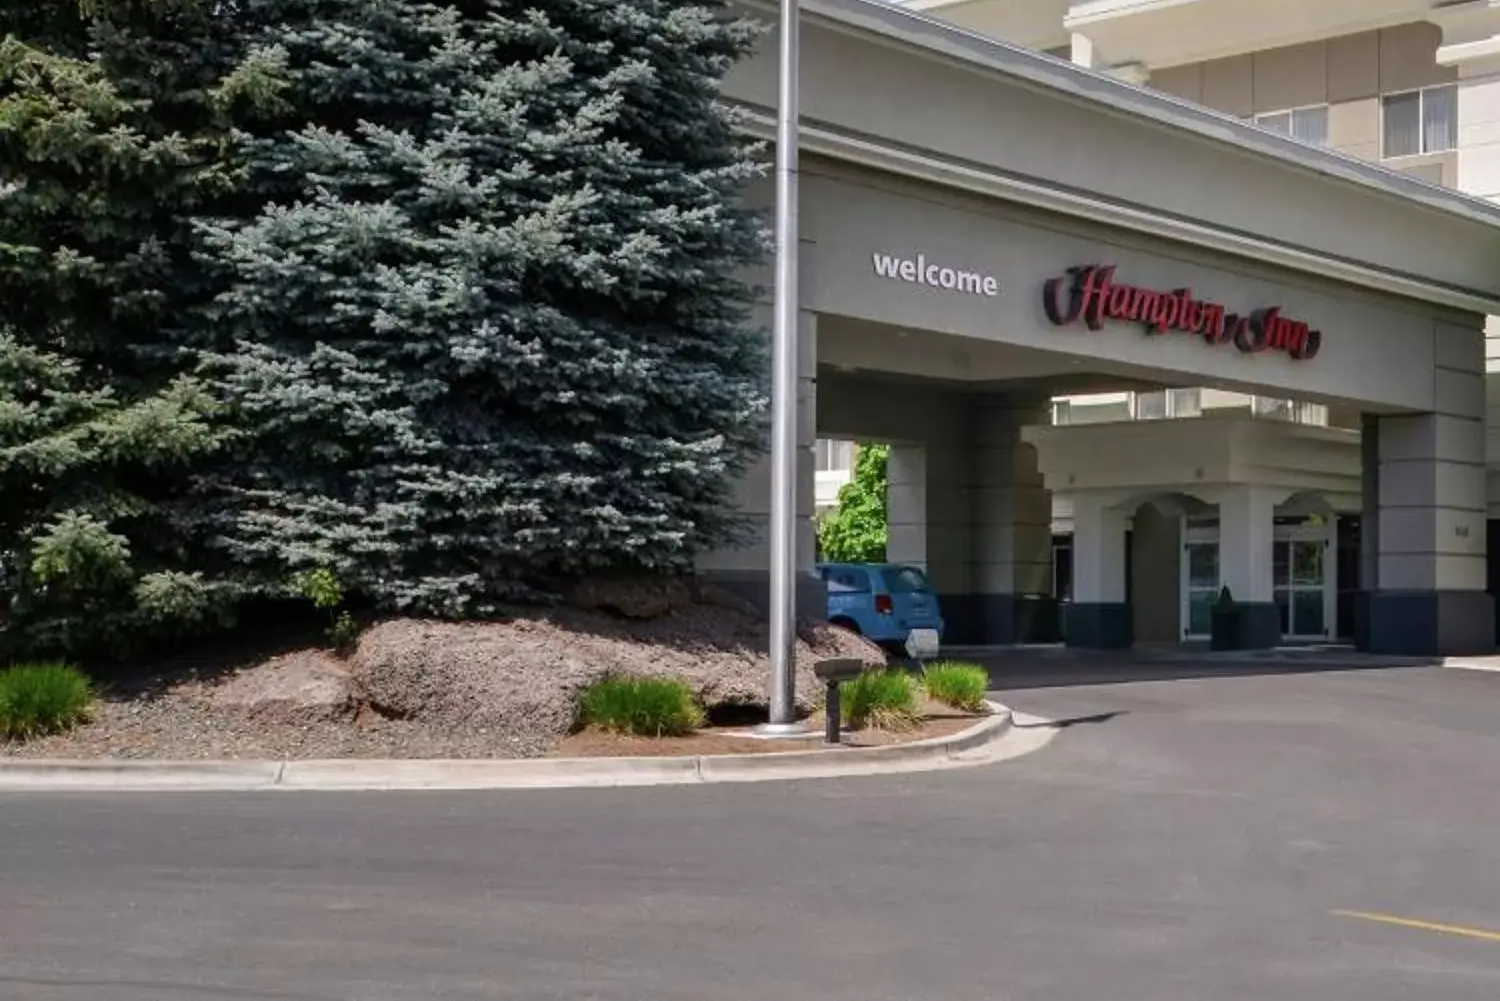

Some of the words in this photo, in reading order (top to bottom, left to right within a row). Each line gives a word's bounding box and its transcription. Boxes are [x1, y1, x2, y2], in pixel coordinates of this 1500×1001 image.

[873, 251, 998, 296] welcome
[1043, 263, 1238, 345] Hampton
[1233, 305, 1322, 360] Inn
